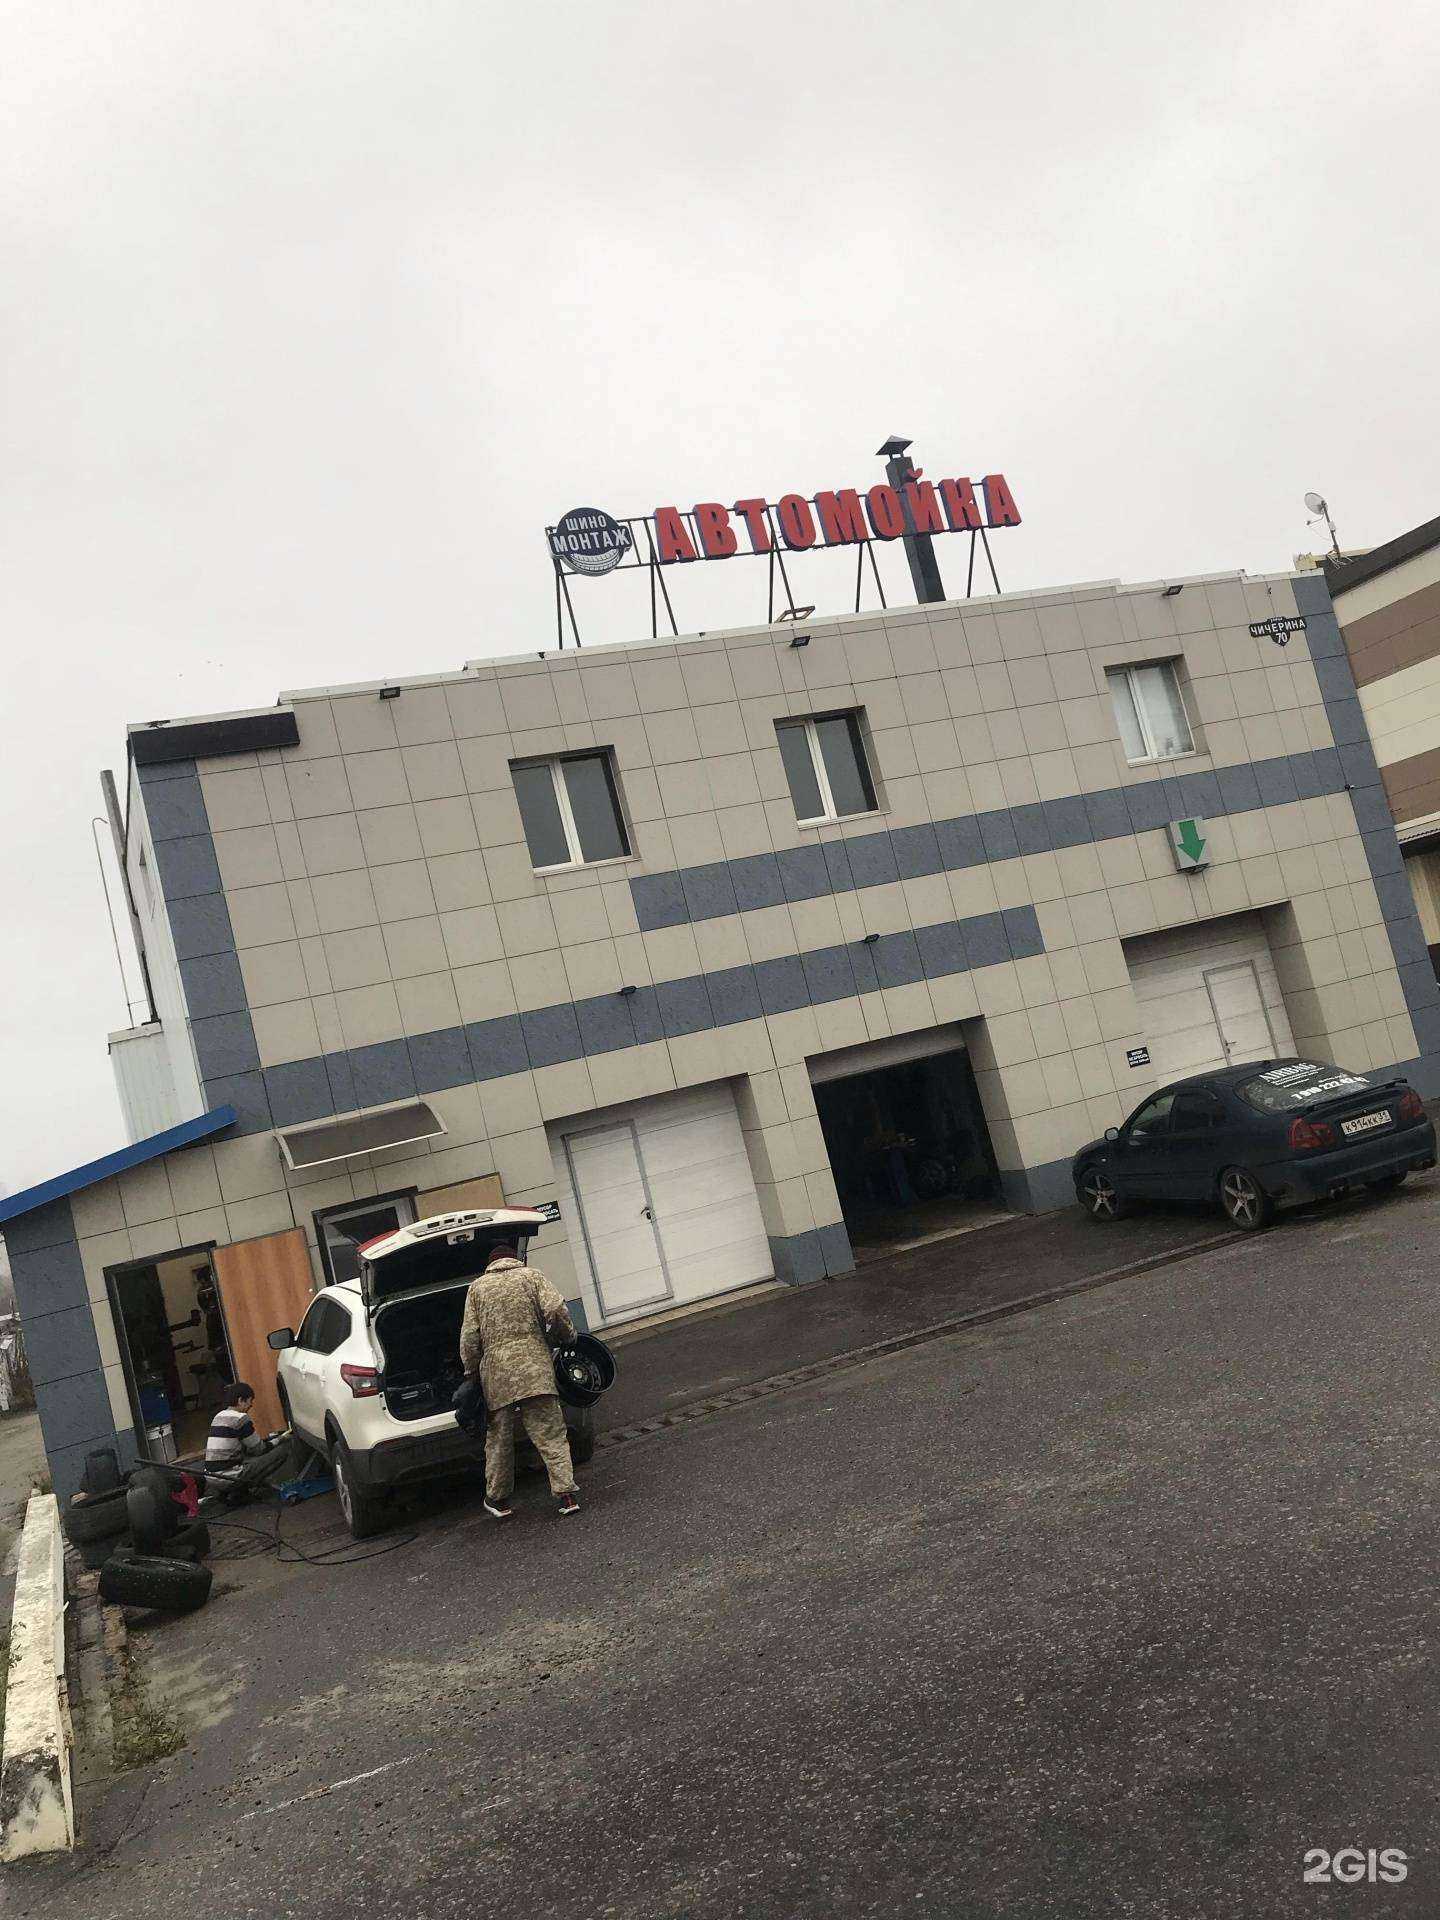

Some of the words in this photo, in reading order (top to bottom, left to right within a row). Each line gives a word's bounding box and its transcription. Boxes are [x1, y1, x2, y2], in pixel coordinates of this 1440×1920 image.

[565, 515, 607, 531] ШИНО
[654, 467, 1022, 565] АВТОМОЙКА
[552, 529, 630, 552] МОНТАЖ
[1250, 619, 1306, 635] ЧИЧЕРИНА
[1275, 631, 1288, 643] 70
